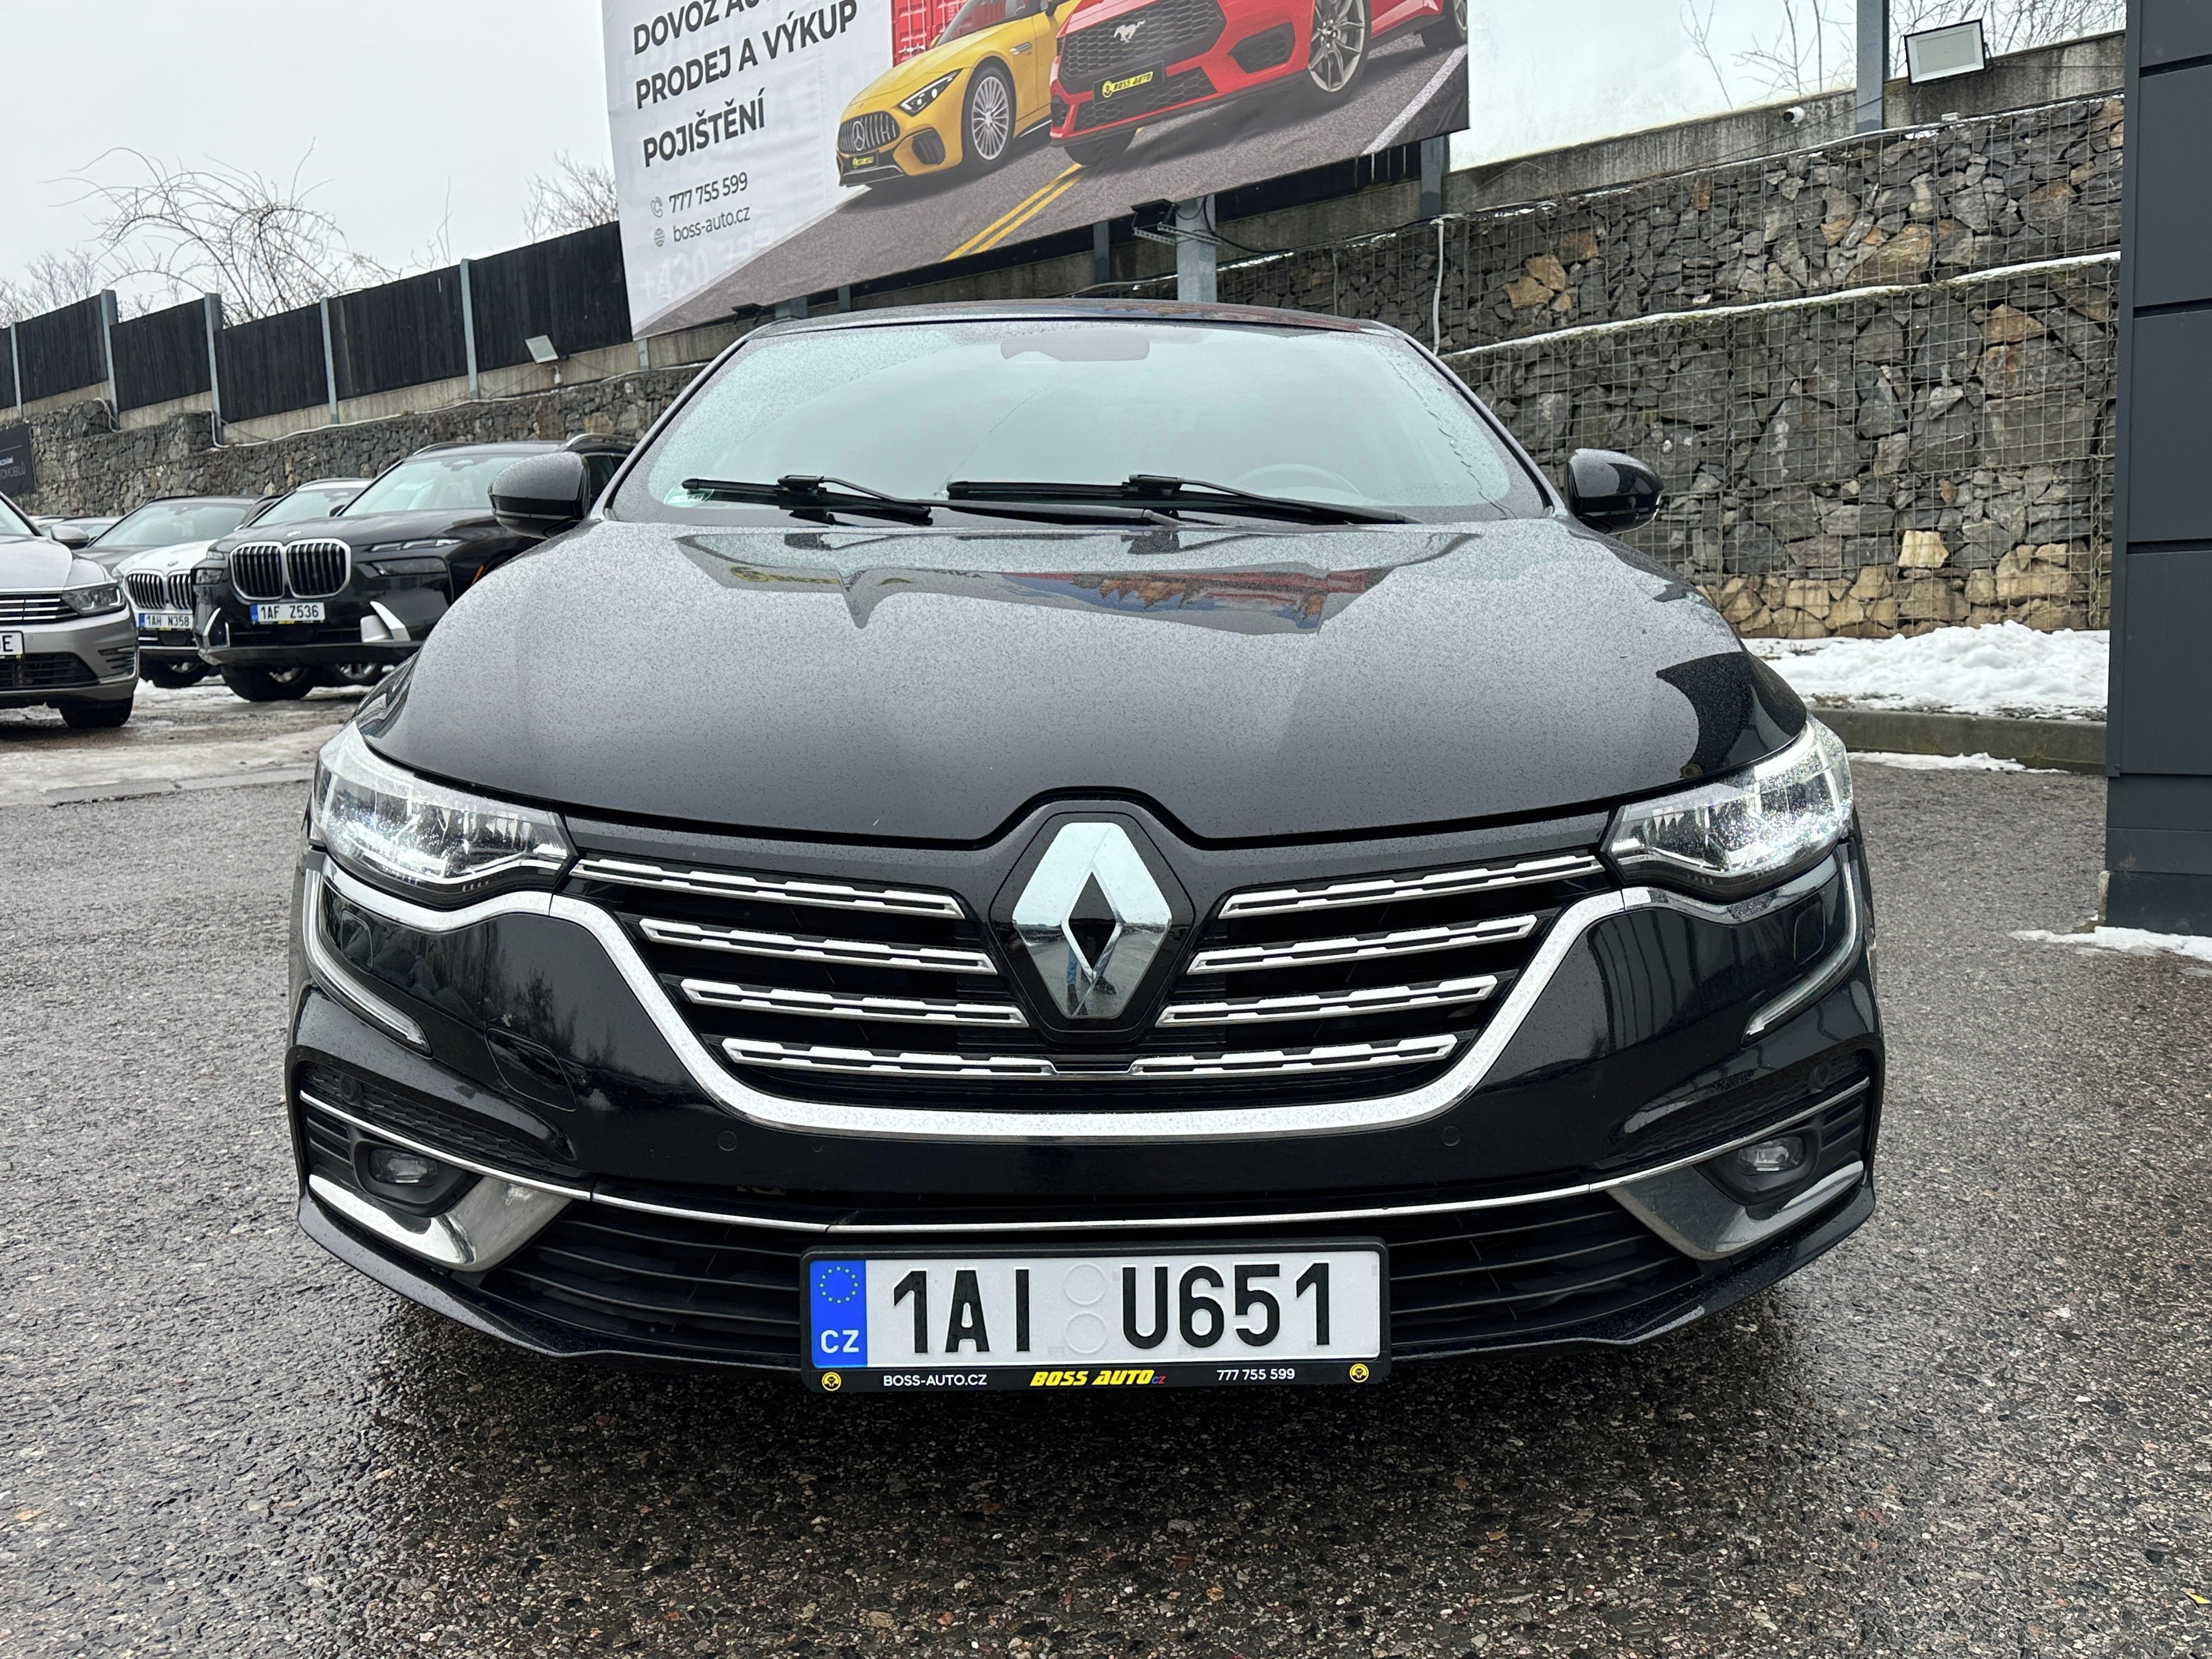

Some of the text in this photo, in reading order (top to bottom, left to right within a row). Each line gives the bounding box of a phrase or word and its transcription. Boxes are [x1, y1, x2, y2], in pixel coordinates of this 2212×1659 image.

[634, 0, 719, 55] DOVOZ
[636, 0, 857, 110] PRODEJ A VÝKUP
[643, 87, 765, 168] POJIŠTĚNÍ
[669, 172, 748, 213] 777 755 599
[673, 207, 751, 242] boss-auto.cz
[146, 615, 189, 627] 1AH N358
[261, 606, 280, 619] 1AF
[289, 605, 319, 618] Z536
[893, 1262, 1330, 1354] 1AI U651
[821, 1330, 859, 1353] CZ
[883, 1374, 988, 1386] BOSS-AUTO.CZ
[1030, 1371, 1089, 1386] BOSS
[1216, 1368, 1295, 1381] 777 755 599
